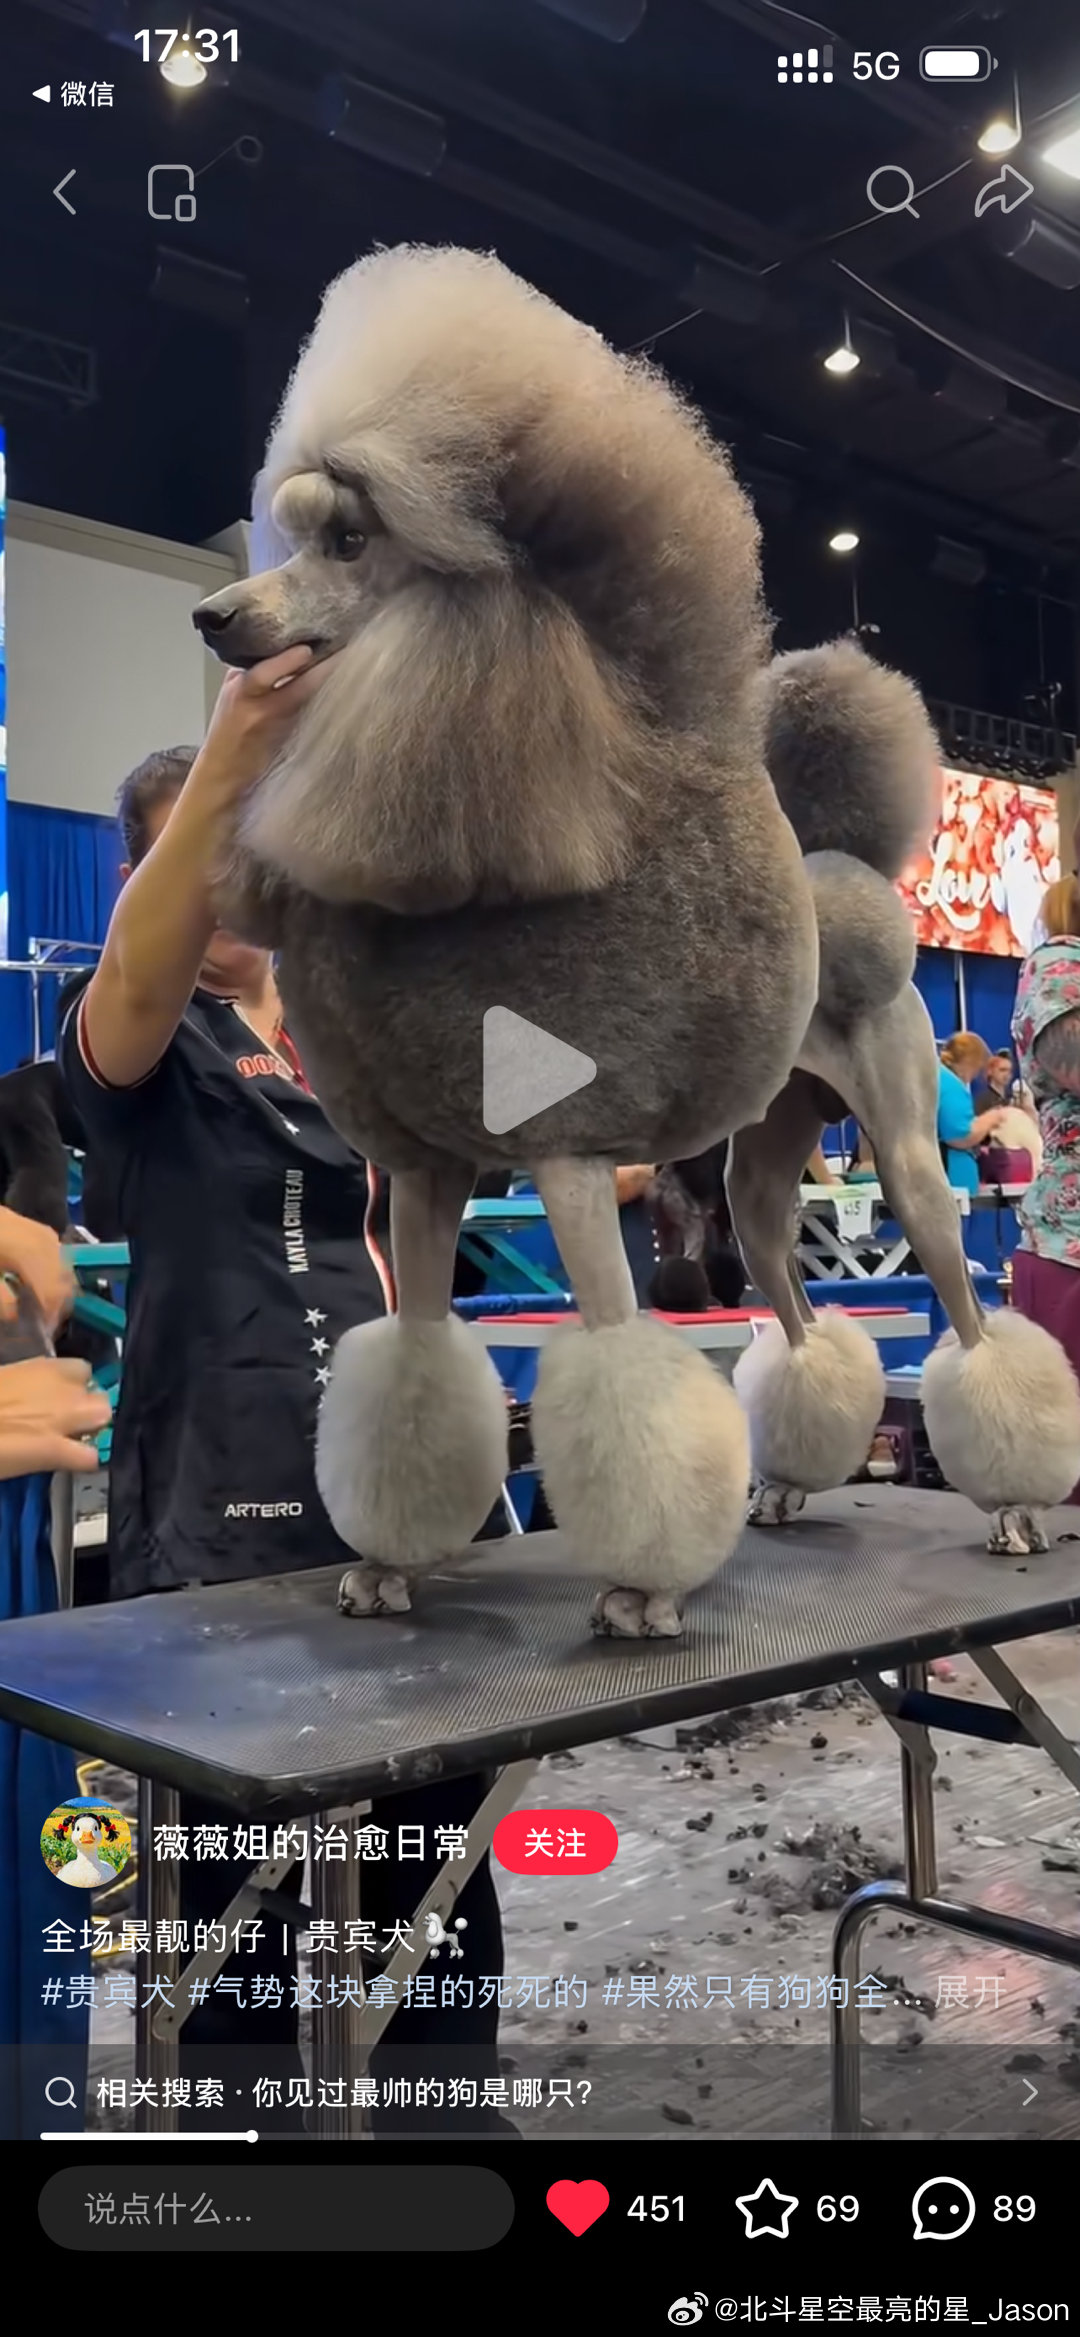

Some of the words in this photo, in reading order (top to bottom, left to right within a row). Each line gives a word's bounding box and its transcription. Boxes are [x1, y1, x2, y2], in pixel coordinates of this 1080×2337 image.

[283, 1169, 304, 1228] CROTEAU
[284, 1228, 310, 1274] KAYLA
[224, 1502, 303, 1518] ARTERO
